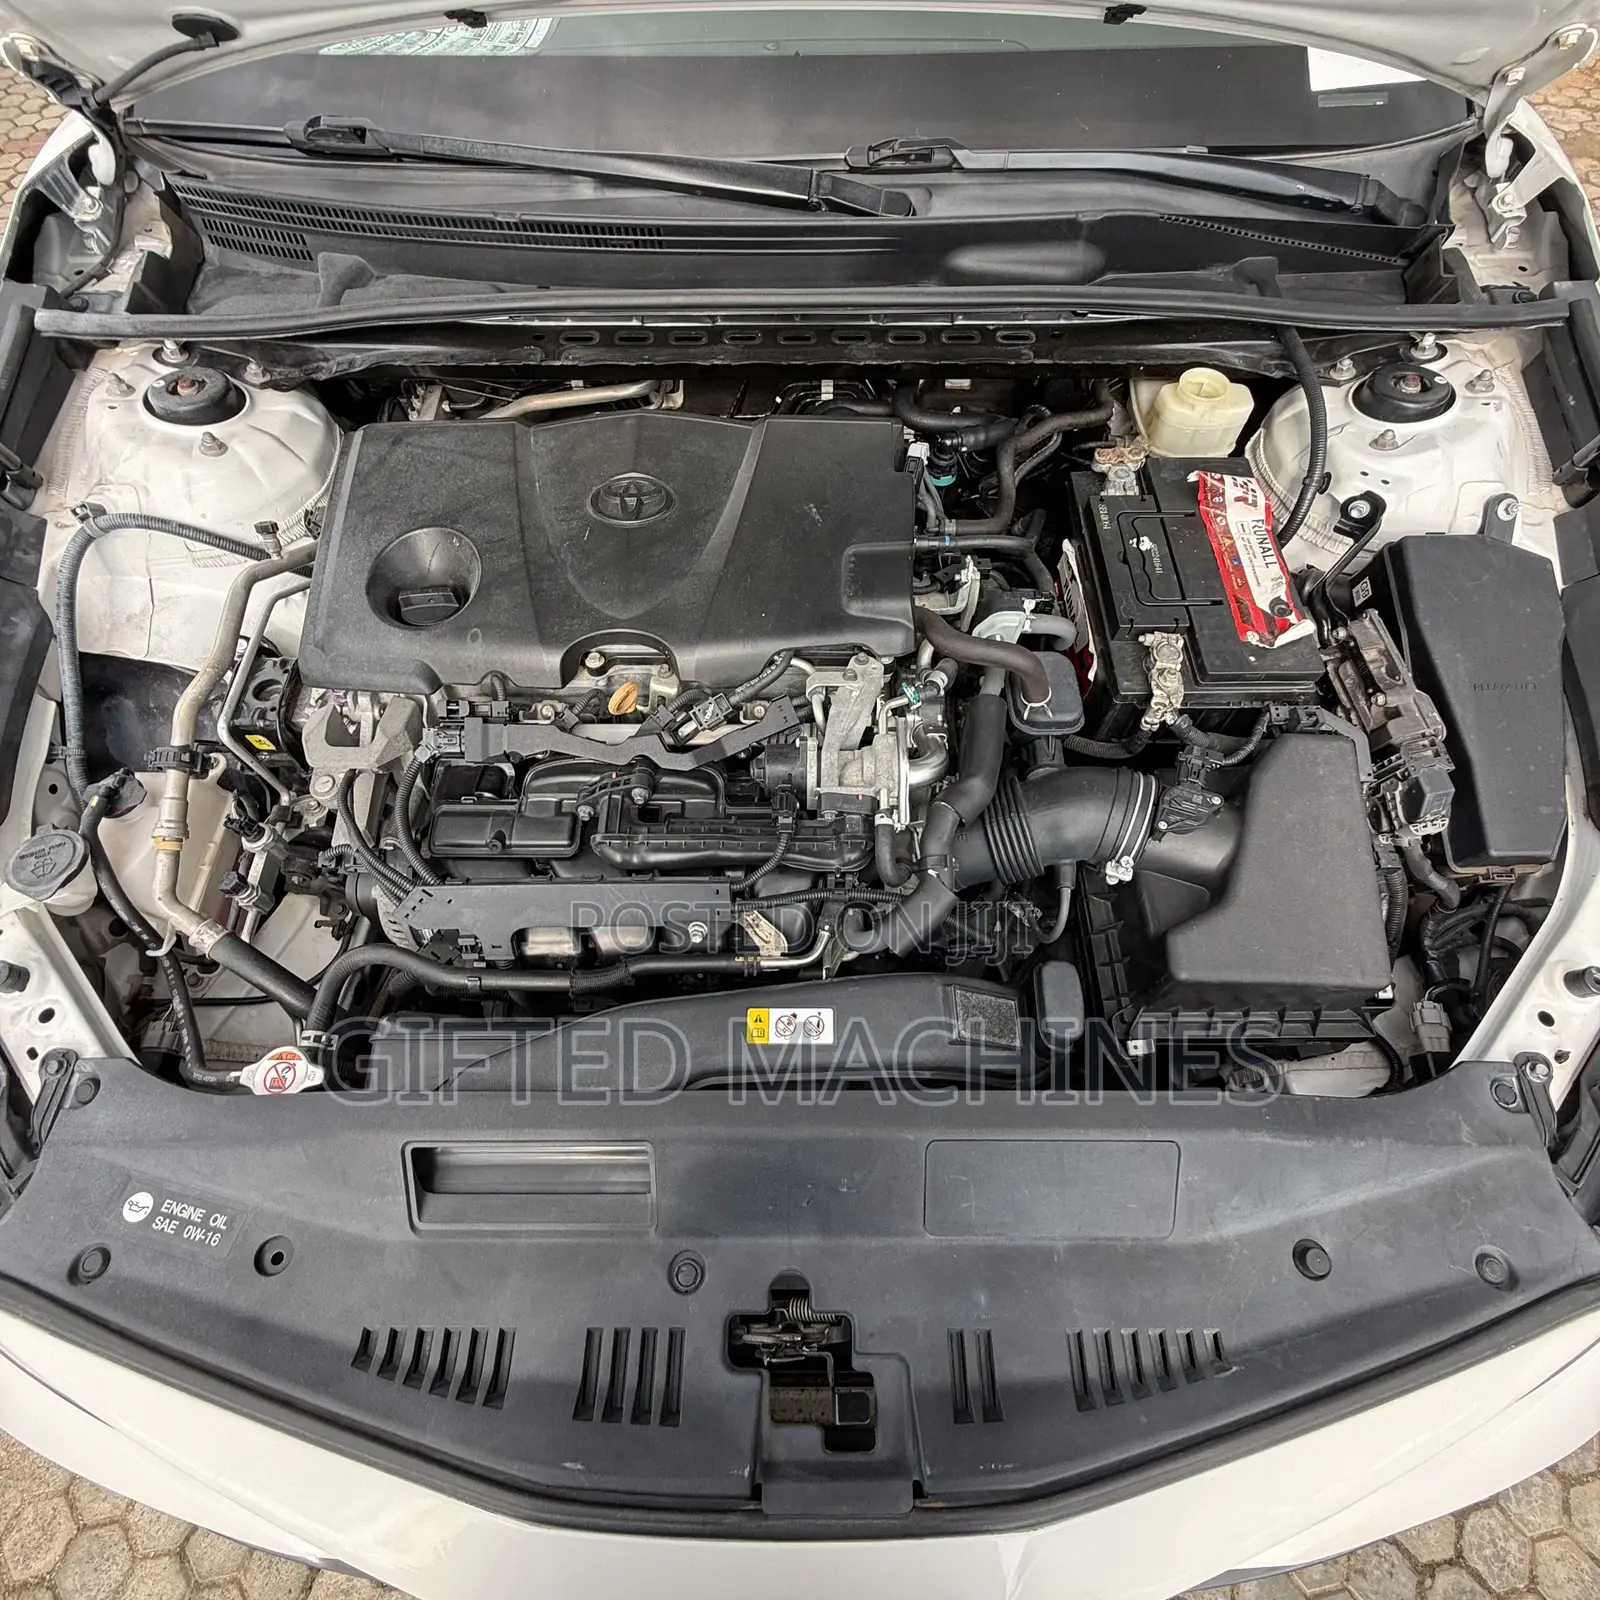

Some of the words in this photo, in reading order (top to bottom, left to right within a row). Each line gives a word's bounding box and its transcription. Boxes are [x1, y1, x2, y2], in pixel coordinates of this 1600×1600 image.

[1252, 519, 1277, 569] RUNALL
[152, 1215, 180, 1234] SAE
[183, 1224, 221, 1247] 0W-16
[160, 1199, 206, 1223] ENGINE
[209, 1213, 228, 1231] OIL
